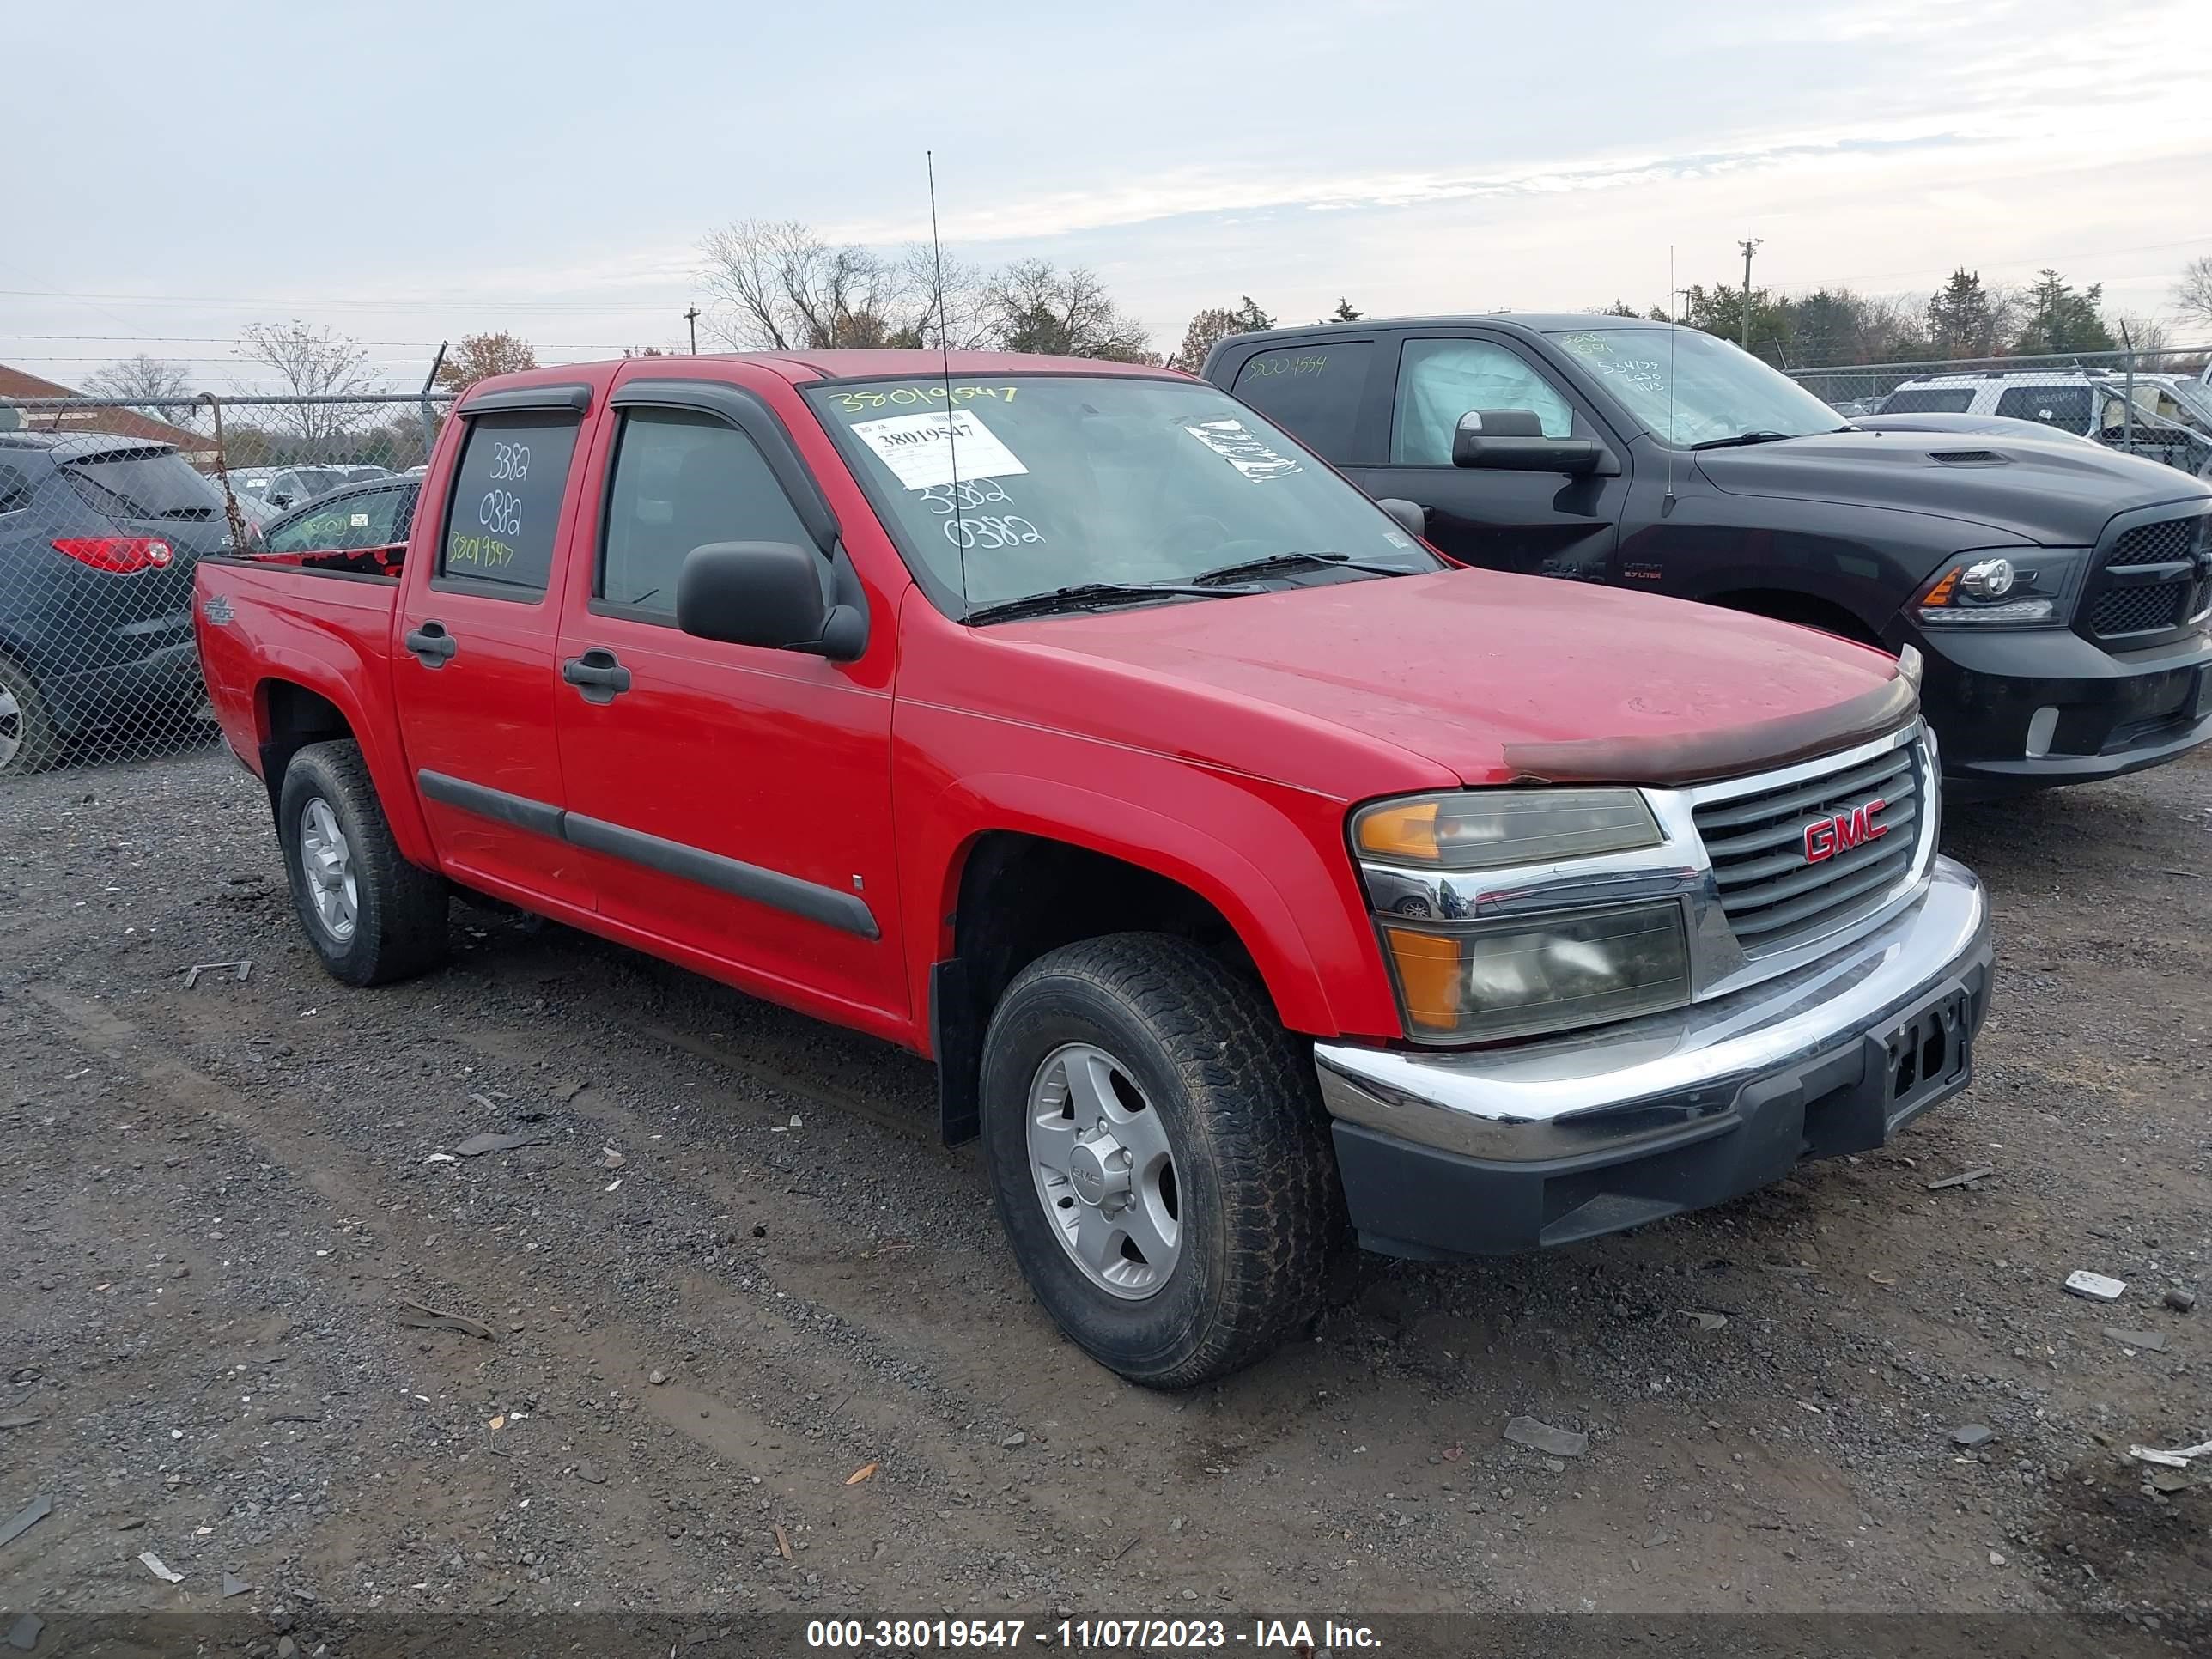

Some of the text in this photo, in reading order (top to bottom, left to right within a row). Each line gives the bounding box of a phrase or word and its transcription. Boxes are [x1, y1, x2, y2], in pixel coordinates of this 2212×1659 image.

[827, 386, 1018, 413] 38019547
[878, 424, 975, 449] 38019547
[489, 441, 531, 481] 3382
[479, 489, 522, 536] 0382
[448, 531, 515, 568] 38019547
[943, 514, 1048, 550] 0382
[1803, 798, 1889, 865] GMC
[1072, 1165, 1102, 1187] GMC
